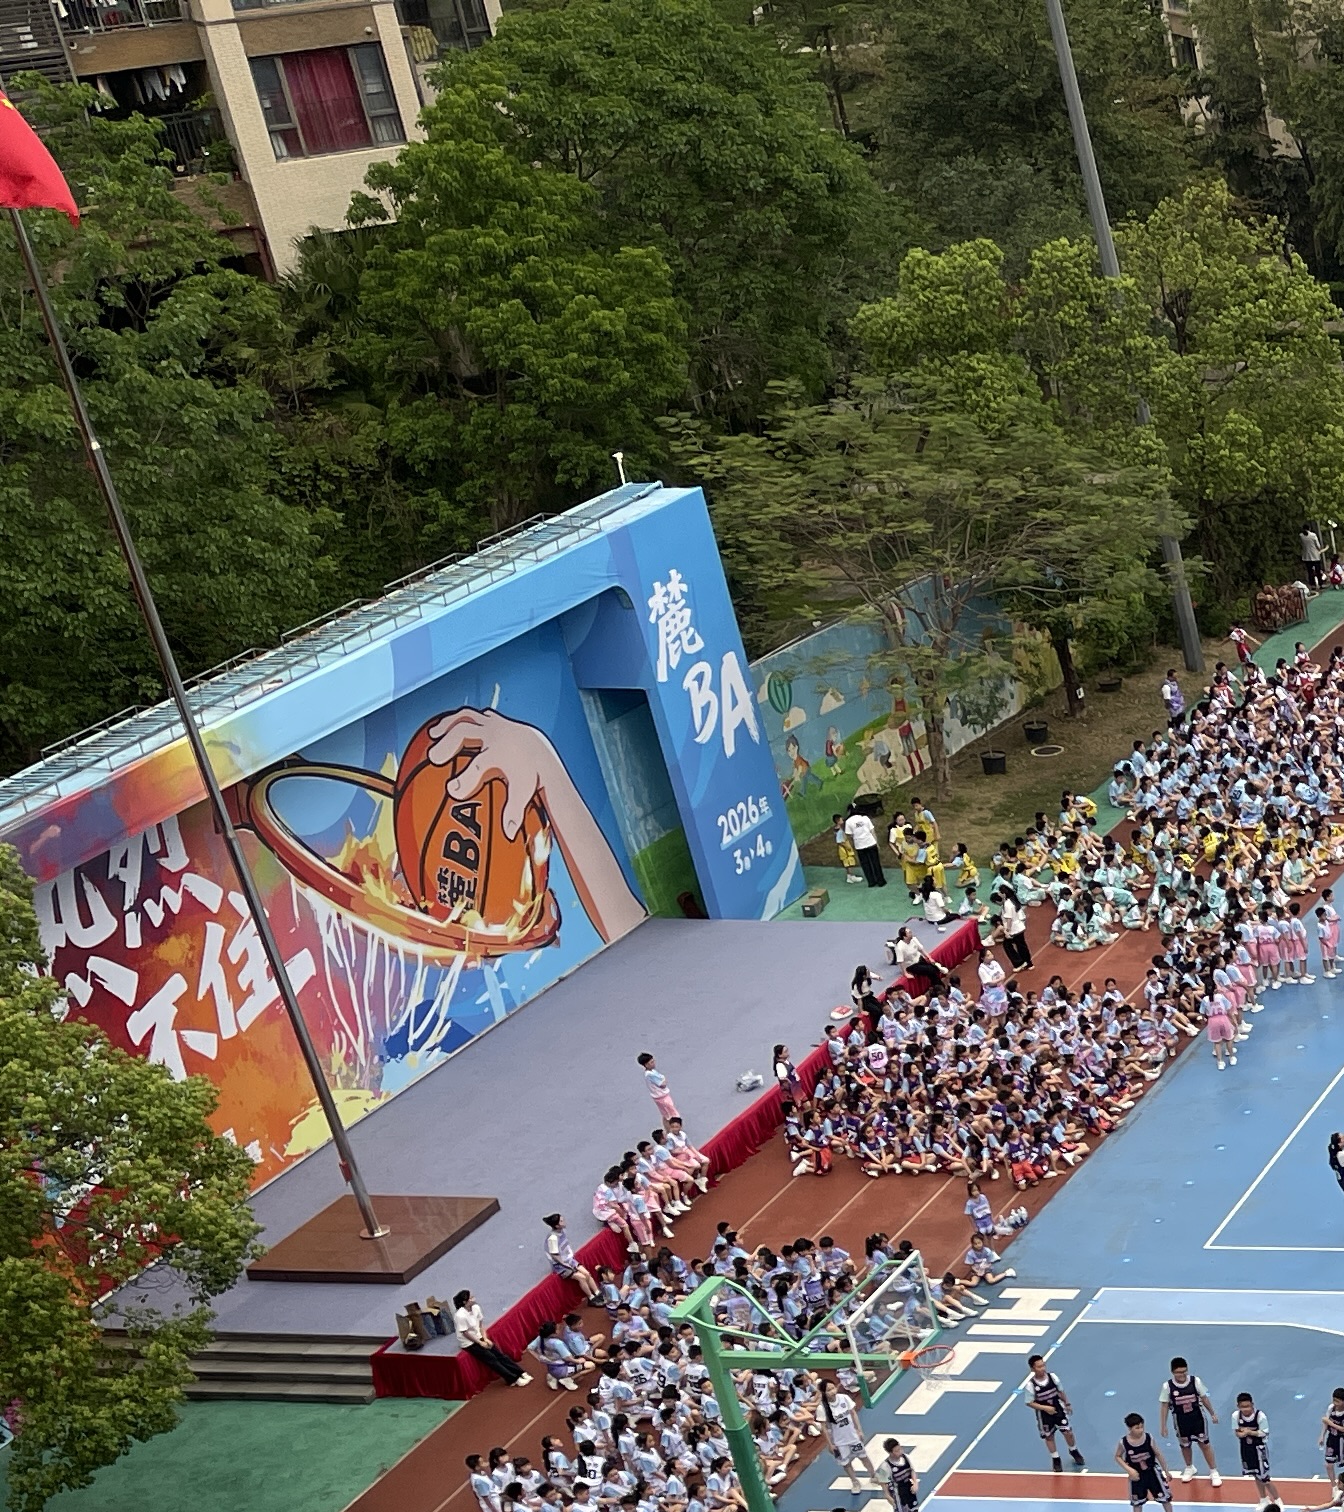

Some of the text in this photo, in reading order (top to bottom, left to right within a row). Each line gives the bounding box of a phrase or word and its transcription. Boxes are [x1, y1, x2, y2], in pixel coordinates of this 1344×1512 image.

[648, 568, 705, 682] 麓
[683, 651, 759, 759] BA
[717, 795, 771, 846] 2026年
